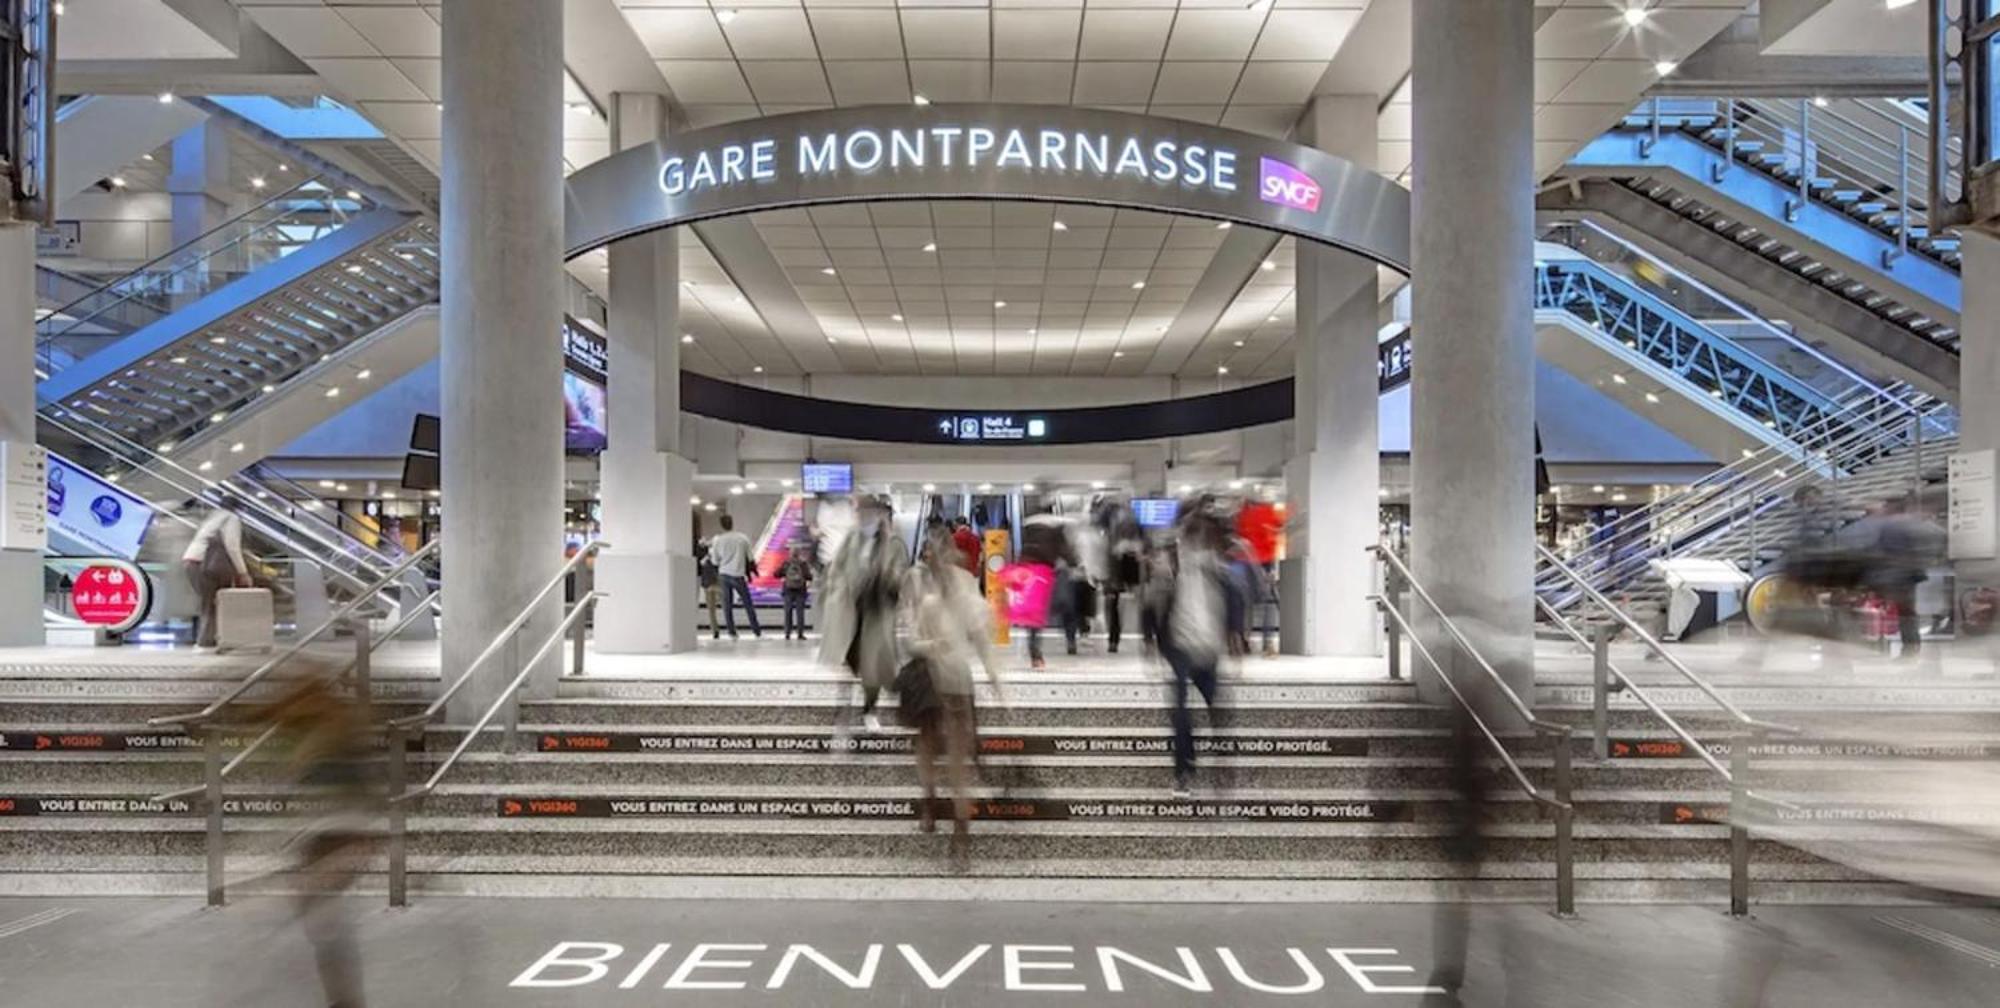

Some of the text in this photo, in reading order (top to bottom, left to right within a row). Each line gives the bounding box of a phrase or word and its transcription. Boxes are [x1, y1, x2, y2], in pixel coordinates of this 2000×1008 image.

[658, 128, 1237, 194] GARE MONTPARNASSE
[1263, 176, 1317, 204] SNCF
[983, 417, 1012, 427] Hall 4
[125, 736, 157, 747] VOUS
[566, 737, 609, 748] VIGI360
[640, 737, 672, 748] VOUS
[675, 738, 718, 748] ENTREZ
[721, 738, 753, 749] DANS
[756, 739, 773, 749] UN
[776, 739, 818, 749] ESPACE
[821, 736, 857, 750] VIDÉO
[1054, 739, 1086, 750] VOUS
[1090, 740, 1133, 750] ENTREZ
[1136, 740, 1168, 751] DANS
[1237, 739, 1273, 752] VIDÉO
[1276, 739, 1332, 752] PROTÉGÉ.
[1706, 745, 1731, 754] VOU
[1787, 745, 1821, 755] DANS
[1824, 745, 1843, 756] UN
[1847, 745, 1889, 756] ESPACE
[39, 800, 75, 812] VOUS
[78, 800, 126, 812] ENTREZ
[169, 801, 189, 812] UN
[243, 799, 283, 812] VIDÉO
[529, 801, 577, 812] VIGI360
[611, 800, 914, 815] VOUS ENTREZ DANS UN ESPACE VIDÉO PROTÉGÉ.
[1069, 803, 1374, 818] VOUS ENTREZ DANS UN ESPACE VIDÉO PROTÉGÉ.
[1815, 809, 1863, 819] ENTREZ
[507, 940, 1447, 995] BIENVENUE
